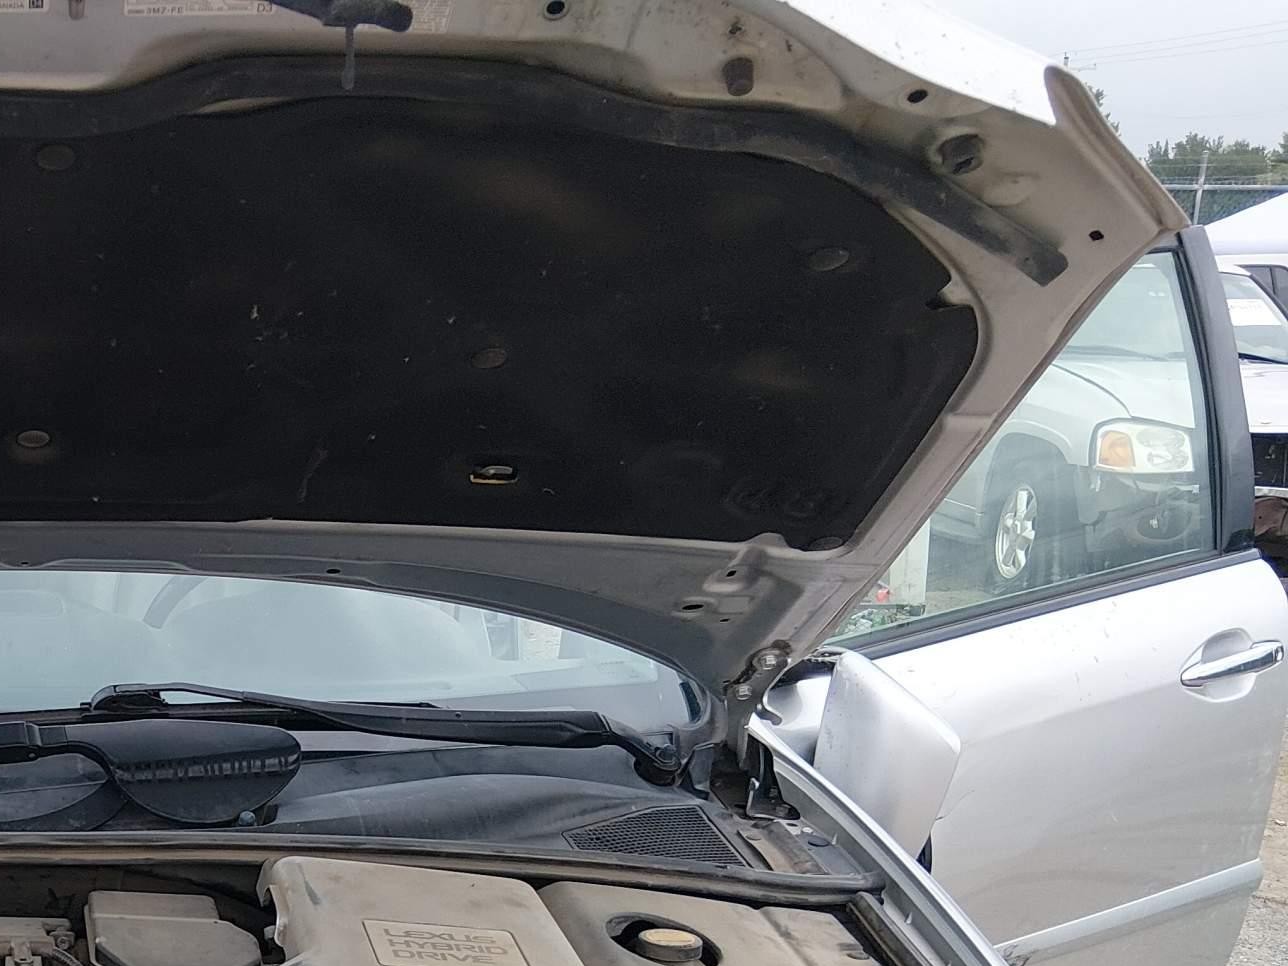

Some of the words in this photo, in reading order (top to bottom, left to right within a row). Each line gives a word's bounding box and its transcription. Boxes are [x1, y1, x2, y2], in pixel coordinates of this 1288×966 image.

[383, 928, 497, 944] LEXUS
[387, 938, 508, 955] HYBRID
[392, 949, 497, 965] DRIVE
